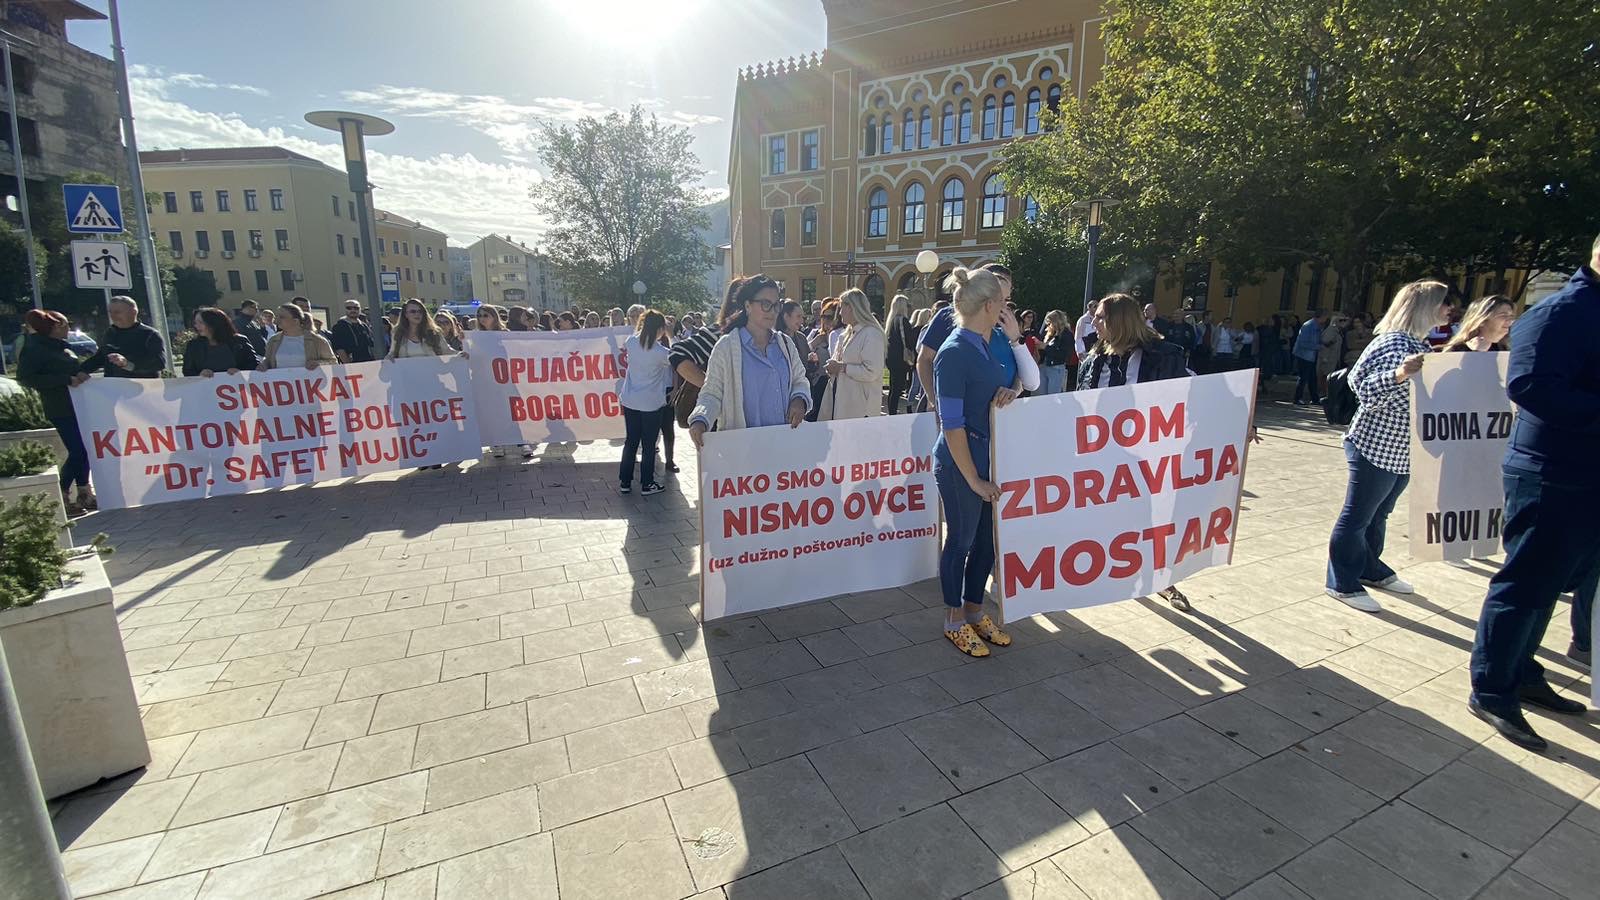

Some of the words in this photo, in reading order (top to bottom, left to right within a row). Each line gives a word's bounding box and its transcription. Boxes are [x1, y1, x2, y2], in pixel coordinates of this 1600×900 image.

[216, 374, 363, 411] SINDIKAT
[509, 393, 580, 422] BOGA
[584, 391, 625, 419] OC
[92, 411, 337, 459] KANTONALNE
[344, 397, 467, 433] BOLNICE
[1075, 402, 1185, 455] DOM
[1422, 412, 1481, 442] DOMA
[1486, 411, 1516, 439] ZD
[145, 462, 215, 490] "Dr.
[224, 446, 328, 483] SAFET
[338, 428, 438, 468] MUJIĆ"
[712, 473, 770, 499] IAKO
[777, 468, 826, 491] SMO
[831, 466, 845, 485] U
[851, 455, 931, 482] BIJELOM
[1000, 444, 1240, 520] ZDRAVLJA
[723, 496, 835, 538] NISMO
[843, 484, 926, 520] OVCE
[1426, 509, 1479, 545] NOVI
[1487, 508, 1504, 539] K
[709, 556, 734, 573] (uz
[738, 548, 789, 565] dužno
[792, 529, 874, 559] poštovanje
[878, 523, 937, 542] ovcama)
[1003, 506, 1233, 599] MOSTAR
